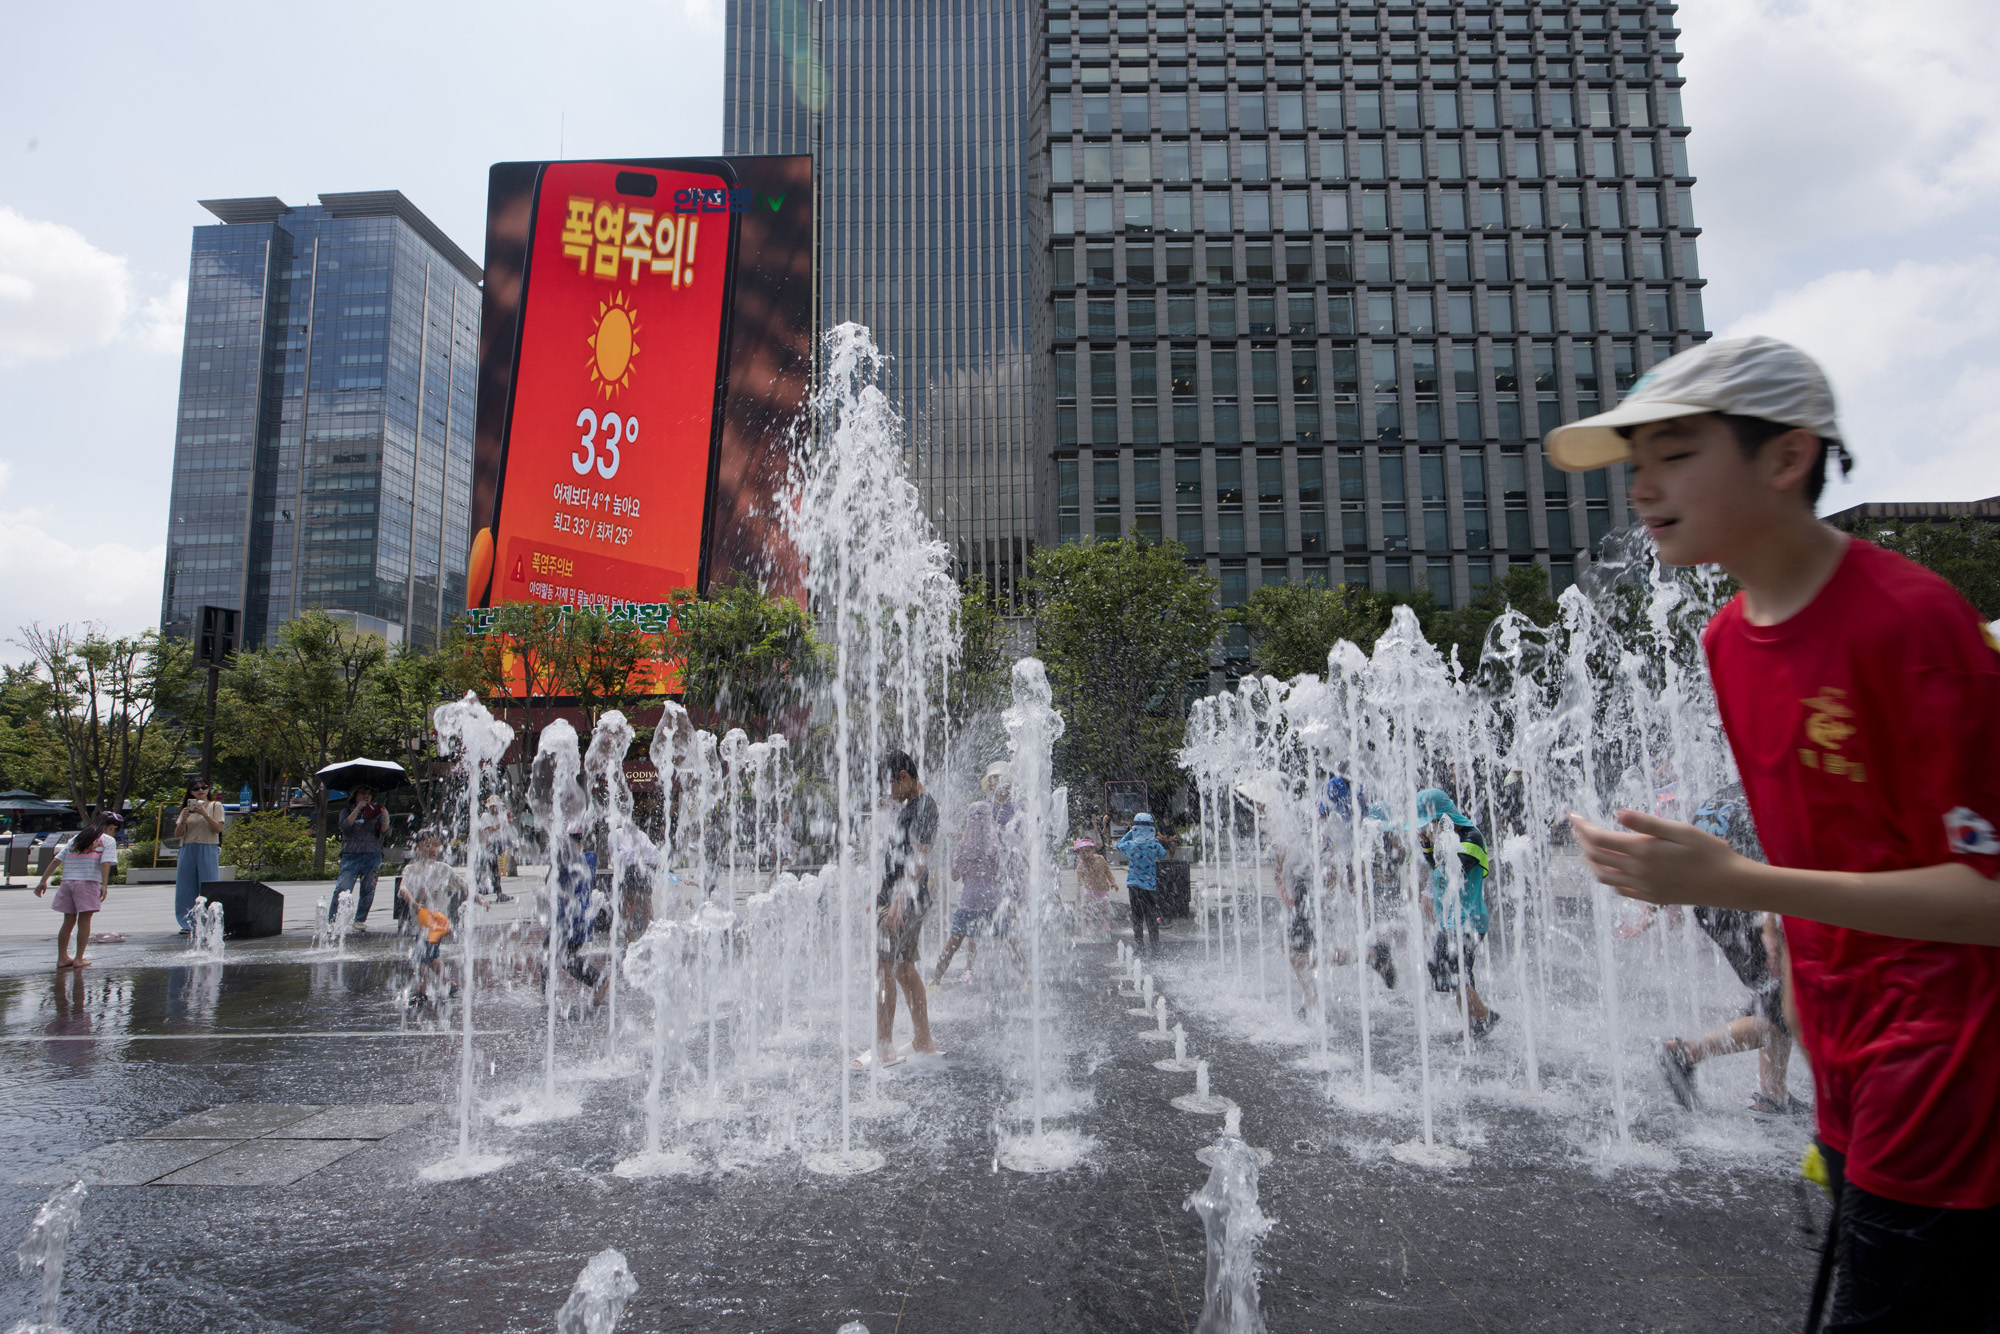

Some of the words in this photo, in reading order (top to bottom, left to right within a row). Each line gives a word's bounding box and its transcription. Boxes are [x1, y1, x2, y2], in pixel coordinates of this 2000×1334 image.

[674, 187, 753, 214] 안전한
[562, 197, 698, 289] 폭염주의!
[572, 408, 639, 480] 33°
[553, 483, 590, 510] 어제보다
[613, 494, 640, 518] 높아요
[553, 512, 571, 532] 최고
[572, 516, 590, 535] 33°
[596, 521, 614, 543] 최저
[614, 526, 633, 546] 25°
[531, 552, 573, 578] 폭염주의보
[625, 771, 659, 779] GODIVA
